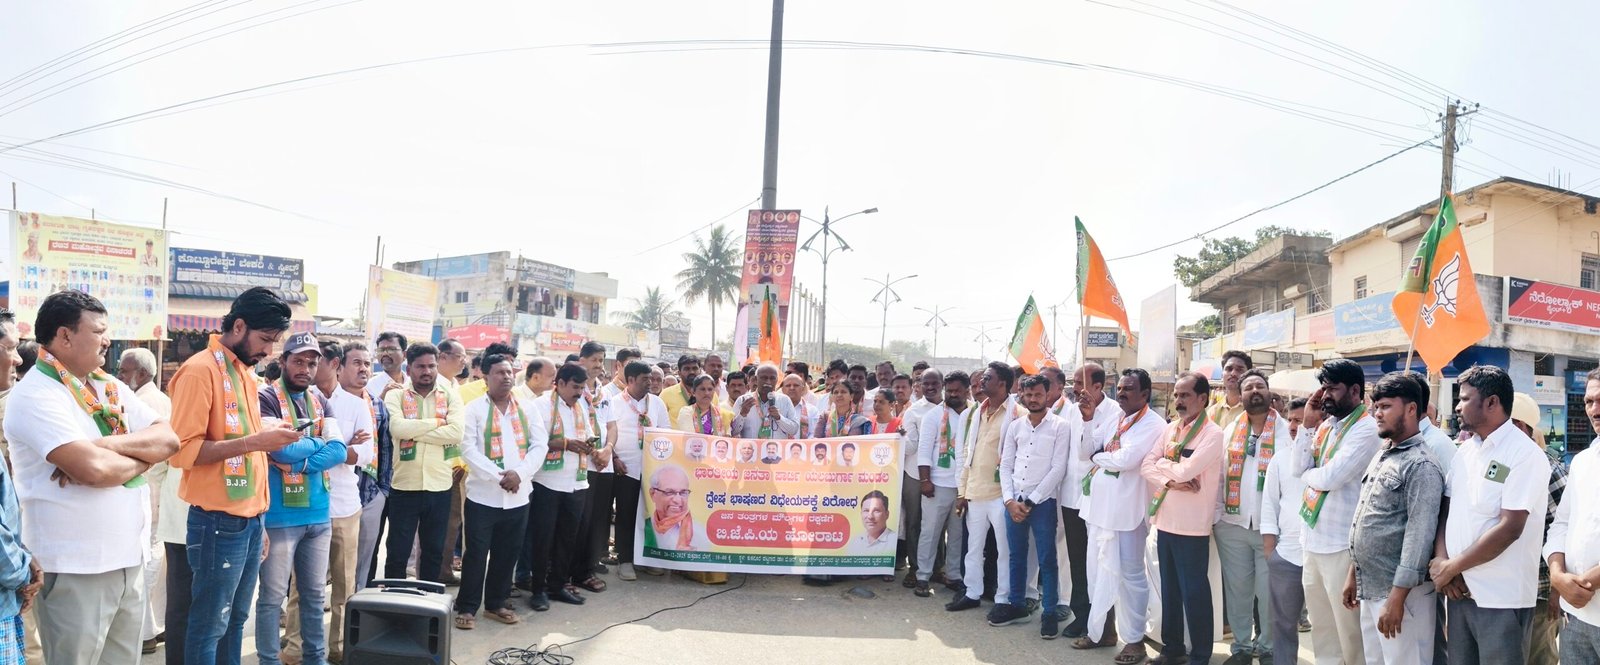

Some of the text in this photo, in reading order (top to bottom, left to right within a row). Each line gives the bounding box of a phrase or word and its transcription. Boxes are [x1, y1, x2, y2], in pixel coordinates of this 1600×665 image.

[239, 257, 265, 269] ಬೇಕರಿ
[268, 262, 274, 271] &
[1529, 291, 1583, 314] ನೆರೋಲ್ಯಾಕ್
[695, 467, 738, 480] ಭಾರತೀಯ
[743, 469, 770, 480] ಜನತಾ
[857, 471, 890, 483] ಮಂಡಲ
[706, 491, 858, 511] ದ್ವೇಷ ಭಾಷಣದ ವಿಧೇಯಕಕ್ಕೆ ವಿರೋಧ
[716, 525, 843, 542] ಬಿ.ಜೆ.ಪಿ.ಯ ಹೋರಾಟ
